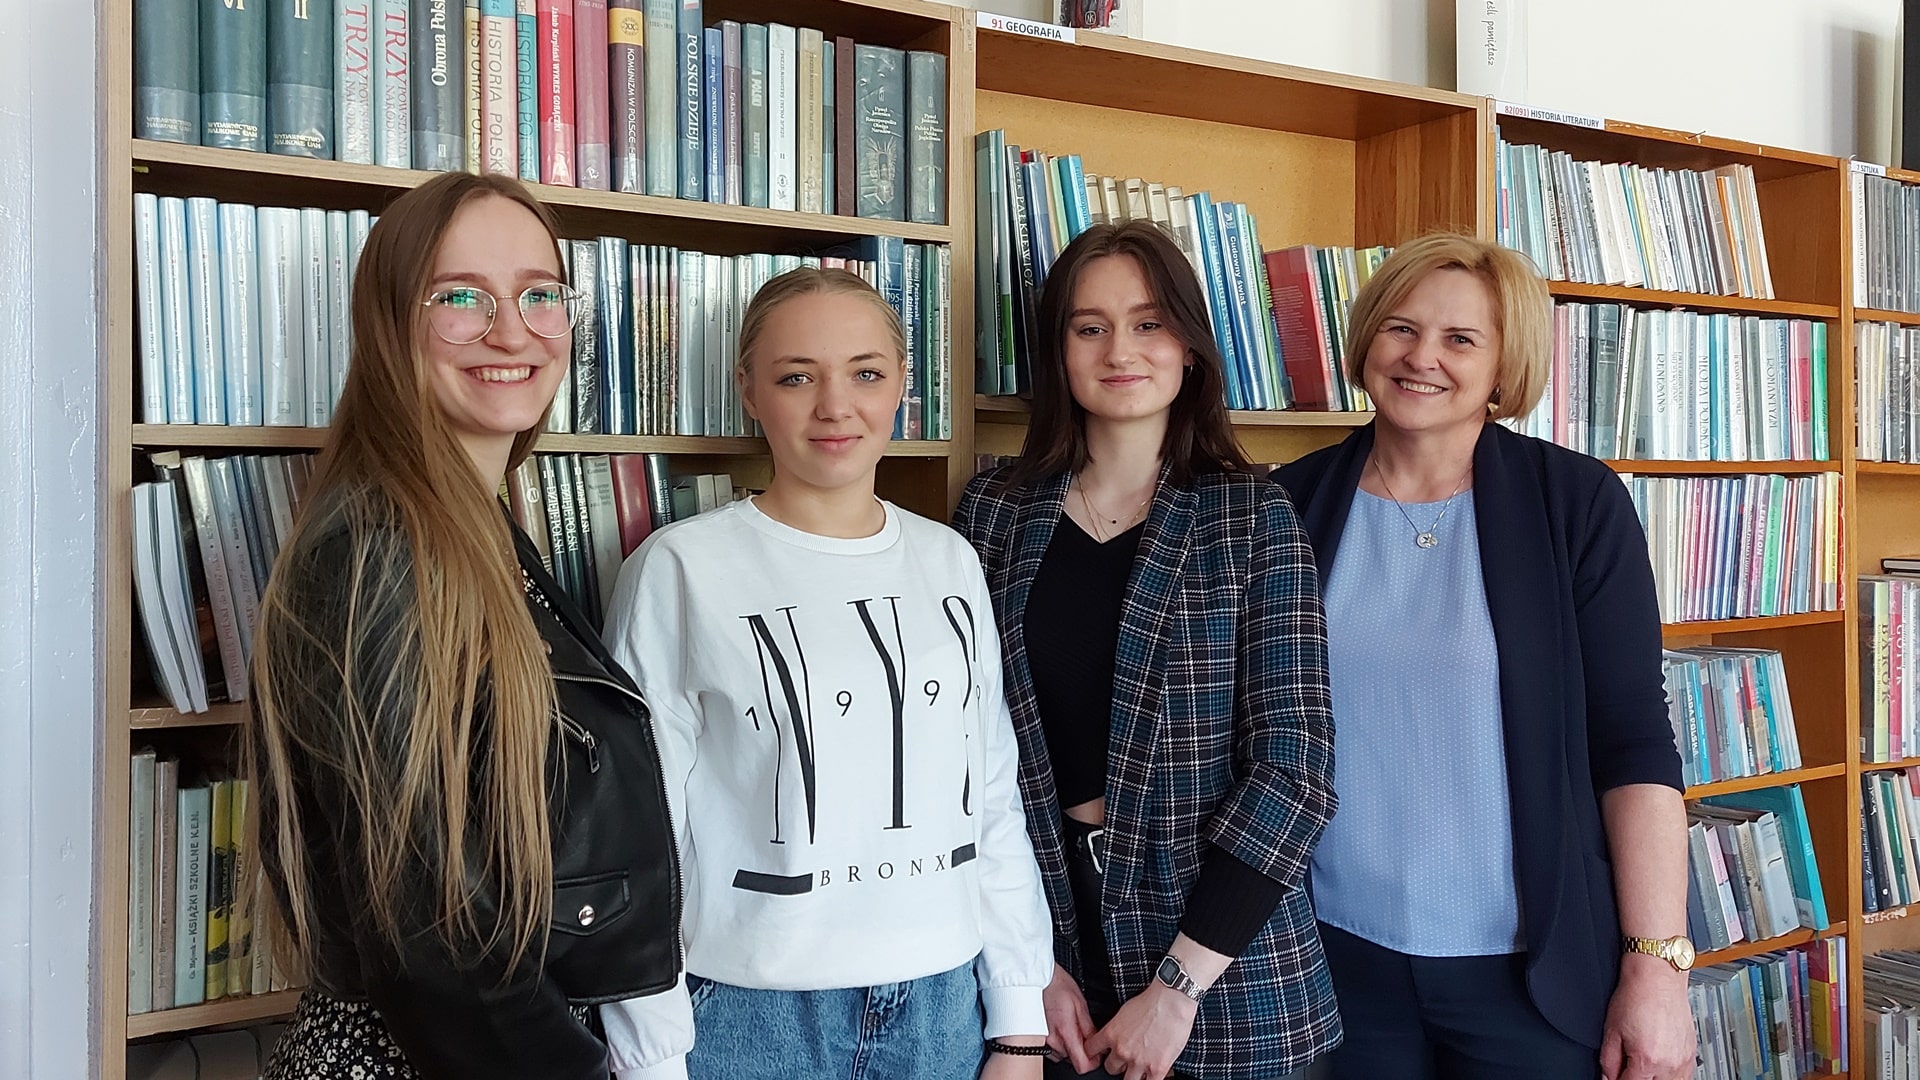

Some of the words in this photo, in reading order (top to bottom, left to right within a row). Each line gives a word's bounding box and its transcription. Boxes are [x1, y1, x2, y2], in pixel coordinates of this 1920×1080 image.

[551, 6, 560, 27] Jakub
[1486, 0, 1498, 16] eśli
[345, 4, 368, 80] TRZY
[551, 28, 560, 62] Karpiński
[991, 18, 1003, 30] 91
[1005, 21, 1062, 40] GEOGRAFIA
[1481, 20, 1496, 66] pamiętasz
[385, 9, 407, 87] TRZY
[431, 33, 447, 87] Obrona
[487, 20, 502, 102] HISTORIA
[518, 20, 532, 102] HISTORIA
[686, 33, 698, 97] POLSKIE
[552, 63, 560, 94] WYKRES
[627, 48, 637, 96] KOMUNIZM
[627, 97, 636, 107] W
[710, 86, 718, 127] ZNIEWOLONE
[729, 91, 737, 111] Epoka
[750, 78, 762, 107] POLSKI
[207, 121, 257, 132] WYDAWNICTWO
[397, 82, 407, 159] POWSTANIA
[550, 94, 561, 132] GORĄCZKI
[628, 108, 637, 143] POLSCE
[686, 98, 699, 150] DZIEJE
[1504, 105, 1530, 118] 82(091)
[1530, 109, 1562, 123] HISTORIA
[1562, 114, 1600, 128] LITERATURY
[207, 128, 240, 136] NAUKOWE
[273, 133, 321, 143] WYDAWNICTWO
[1014, 161, 1023, 191] JACEK
[1860, 165, 1880, 175] SZTUKA
[1015, 195, 1034, 288] PAŁKIEWICZ
[913, 258, 921, 282] Andrzej
[1228, 235, 1243, 278] Cudowny
[1236, 280, 1248, 307] świat
[906, 297, 915, 325] dziejów
[913, 282, 921, 320] Paczkowski
[906, 326, 914, 350] Polski
[1655, 353, 1665, 414] RENESANS
[1698, 354, 1709, 397] MŁODA
[1766, 357, 1778, 429] ROMANTYZM
[1699, 401, 1710, 451] POLSKA
[546, 486, 561, 520] DZIEJE
[561, 483, 574, 517] DZIEJE
[575, 480, 585, 507] DZIEJE
[551, 520, 565, 555] POLSKI
[565, 517, 578, 552] POLSKI
[579, 506, 590, 534] POLSKI
[1756, 502, 1767, 556] LEKSYKON
[228, 642, 242, 686] HISTORIA
[1881, 624, 1890, 705] BAROK
[1689, 716, 1700, 758] POLSKA
[189, 842, 199, 890] SZKOLNE
[820, 854, 946, 887] BRONX
[188, 893, 200, 936] KSIĄŻKI
